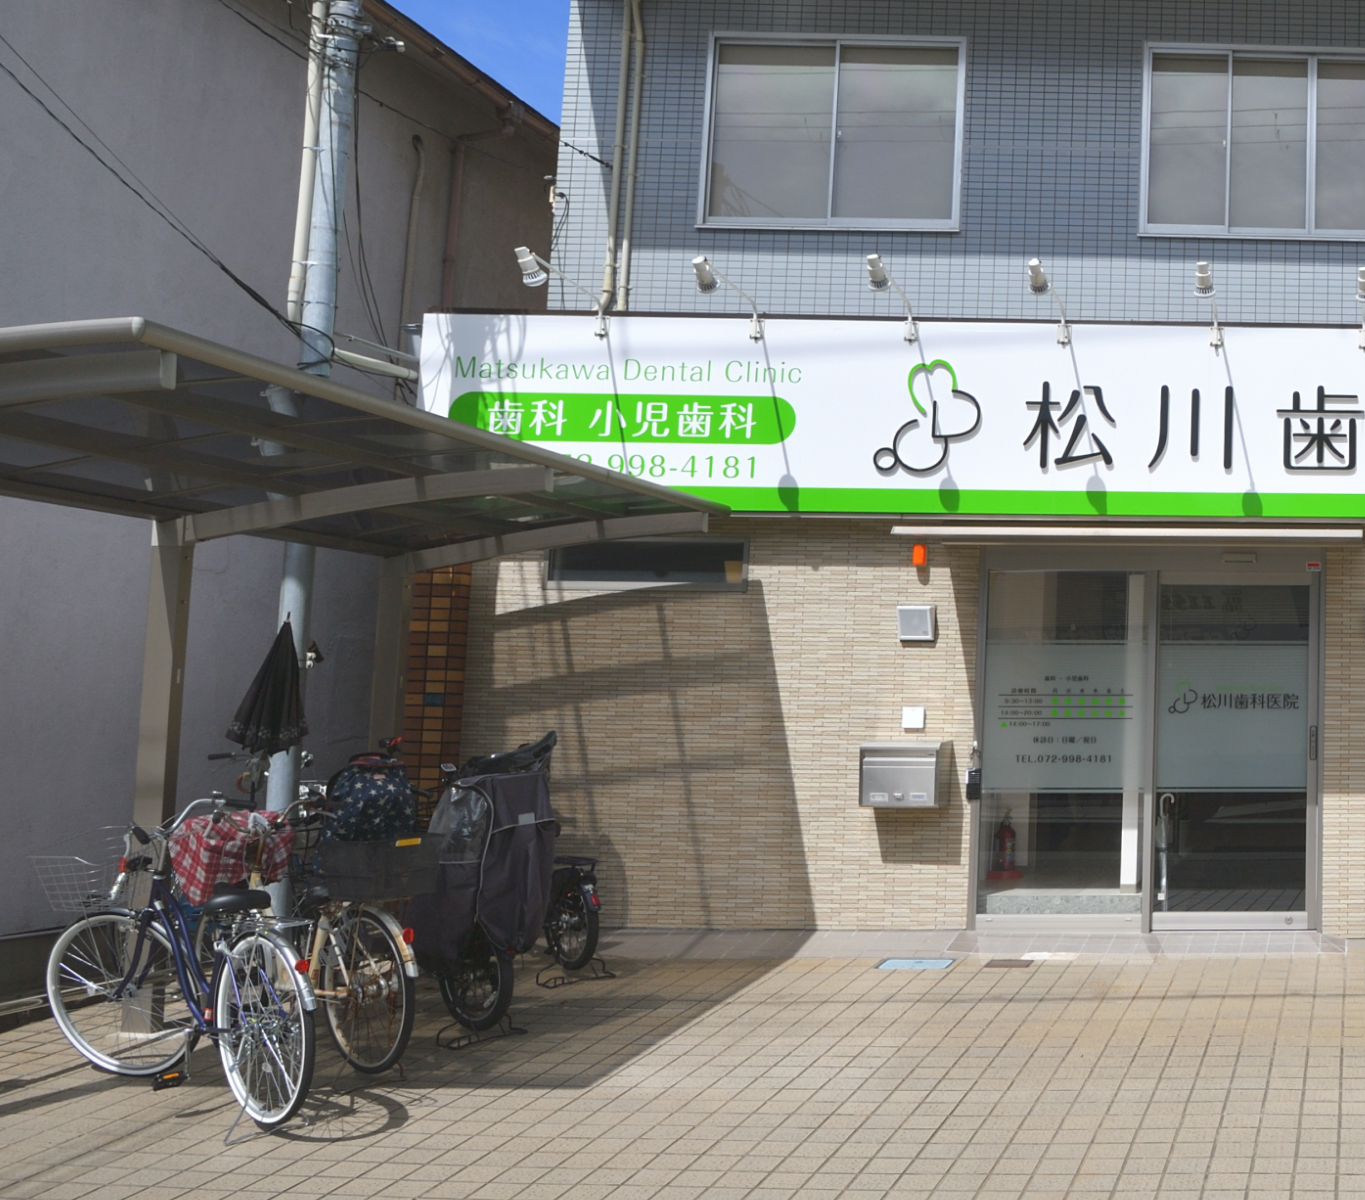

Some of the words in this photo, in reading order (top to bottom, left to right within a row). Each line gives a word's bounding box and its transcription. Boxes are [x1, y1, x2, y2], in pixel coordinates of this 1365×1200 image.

[454, 355, 610, 381] Matsukawa
[623, 358, 711, 382] Dental
[724, 360, 802, 384] Clinic
[487, 399, 567, 436] 歯科
[589, 400, 757, 439] 小児歯科
[1200, 693, 1299, 709] 松川歯科医院
